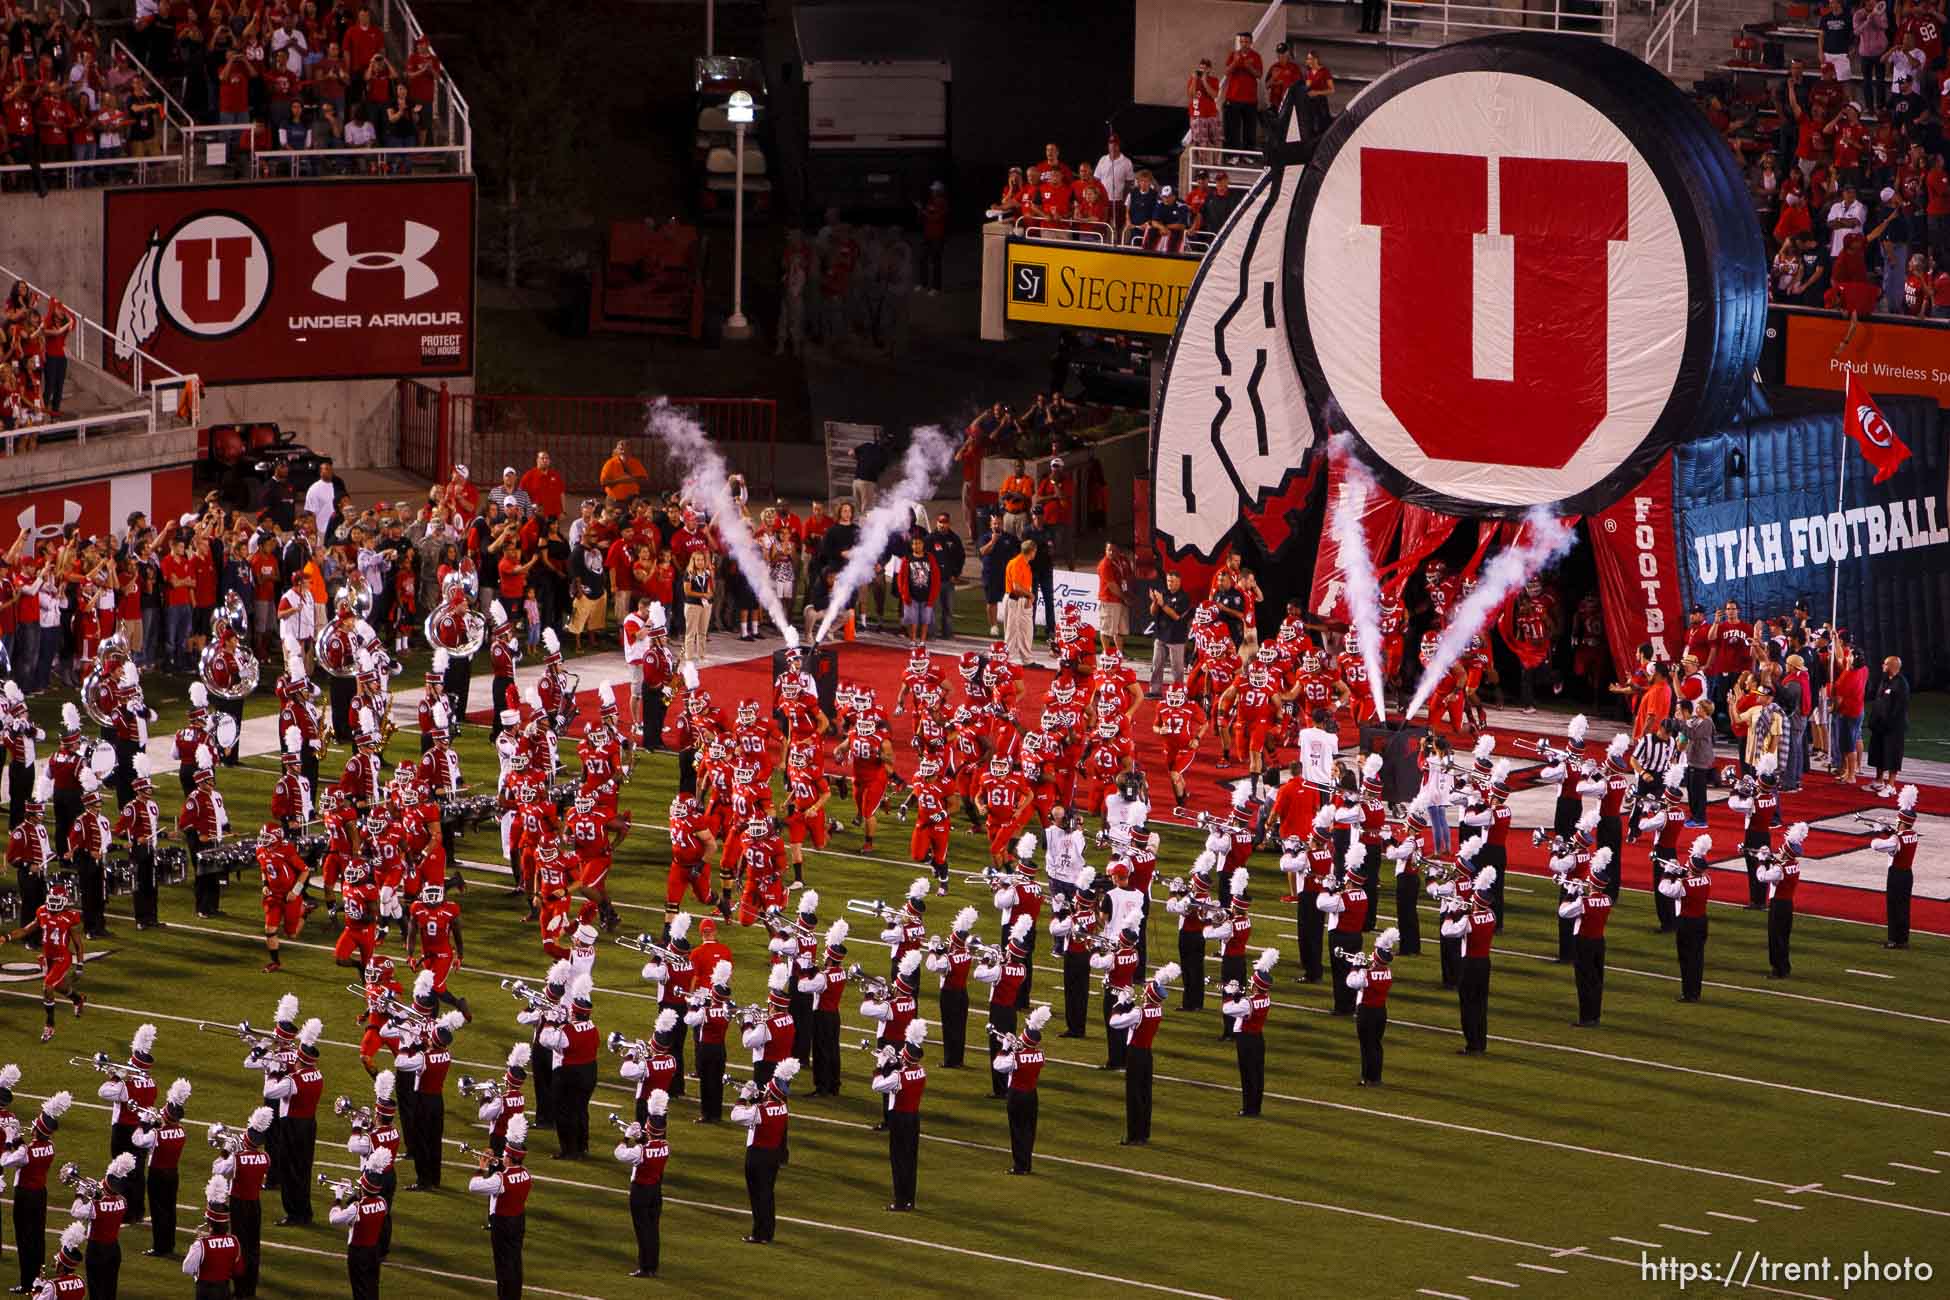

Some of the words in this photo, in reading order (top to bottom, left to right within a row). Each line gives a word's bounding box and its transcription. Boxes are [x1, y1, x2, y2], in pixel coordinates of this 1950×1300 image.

[1919, 23, 1938, 42] 92
[175, 236, 253, 325] U
[1361, 148, 1627, 469] U
[288, 315, 362, 329] UNDER
[367, 312, 462, 328] ARMOUR
[421, 335, 461, 346] PROTECT
[436, 346, 461, 356] HOUSE
[1830, 359, 1868, 375] Proud
[1873, 363, 1927, 381] Wireless
[1694, 521, 1786, 585] UTAH
[1790, 496, 1949, 568] FOOTBALL
[1723, 630, 1748, 640] UTAH
[1246, 691, 1267, 707] 97
[992, 789, 1010, 806] 61
